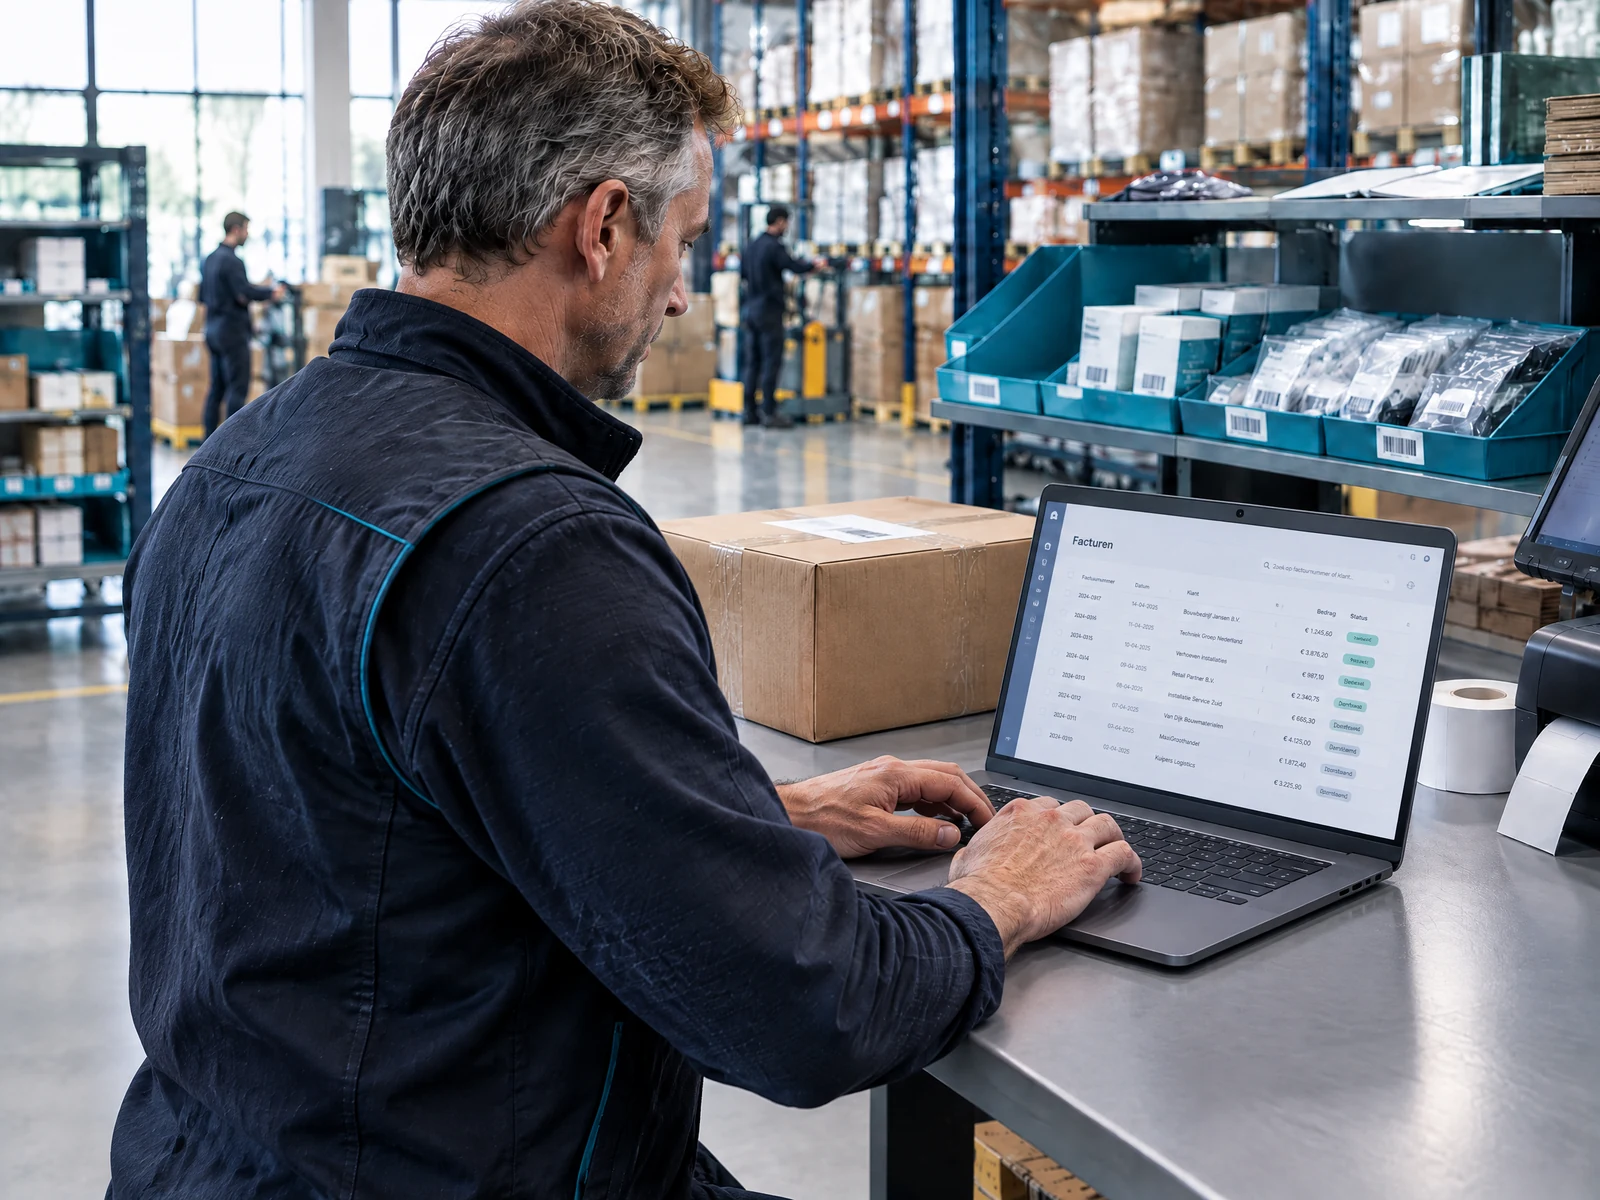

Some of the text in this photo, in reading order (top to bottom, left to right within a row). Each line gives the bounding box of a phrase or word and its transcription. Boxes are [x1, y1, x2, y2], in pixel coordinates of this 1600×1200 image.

[1072, 536, 1113, 549] Facturen
[1317, 609, 1336, 617] Bedrag
[1350, 613, 1368, 621] Status
[1180, 630, 1200, 638] Techniek
[1202, 633, 1216, 641] Groep
[1192, 696, 1210, 704] Service
[1112, 703, 1139, 712] 07-04-2025
[1155, 755, 1195, 768] Kuipers Logistics
